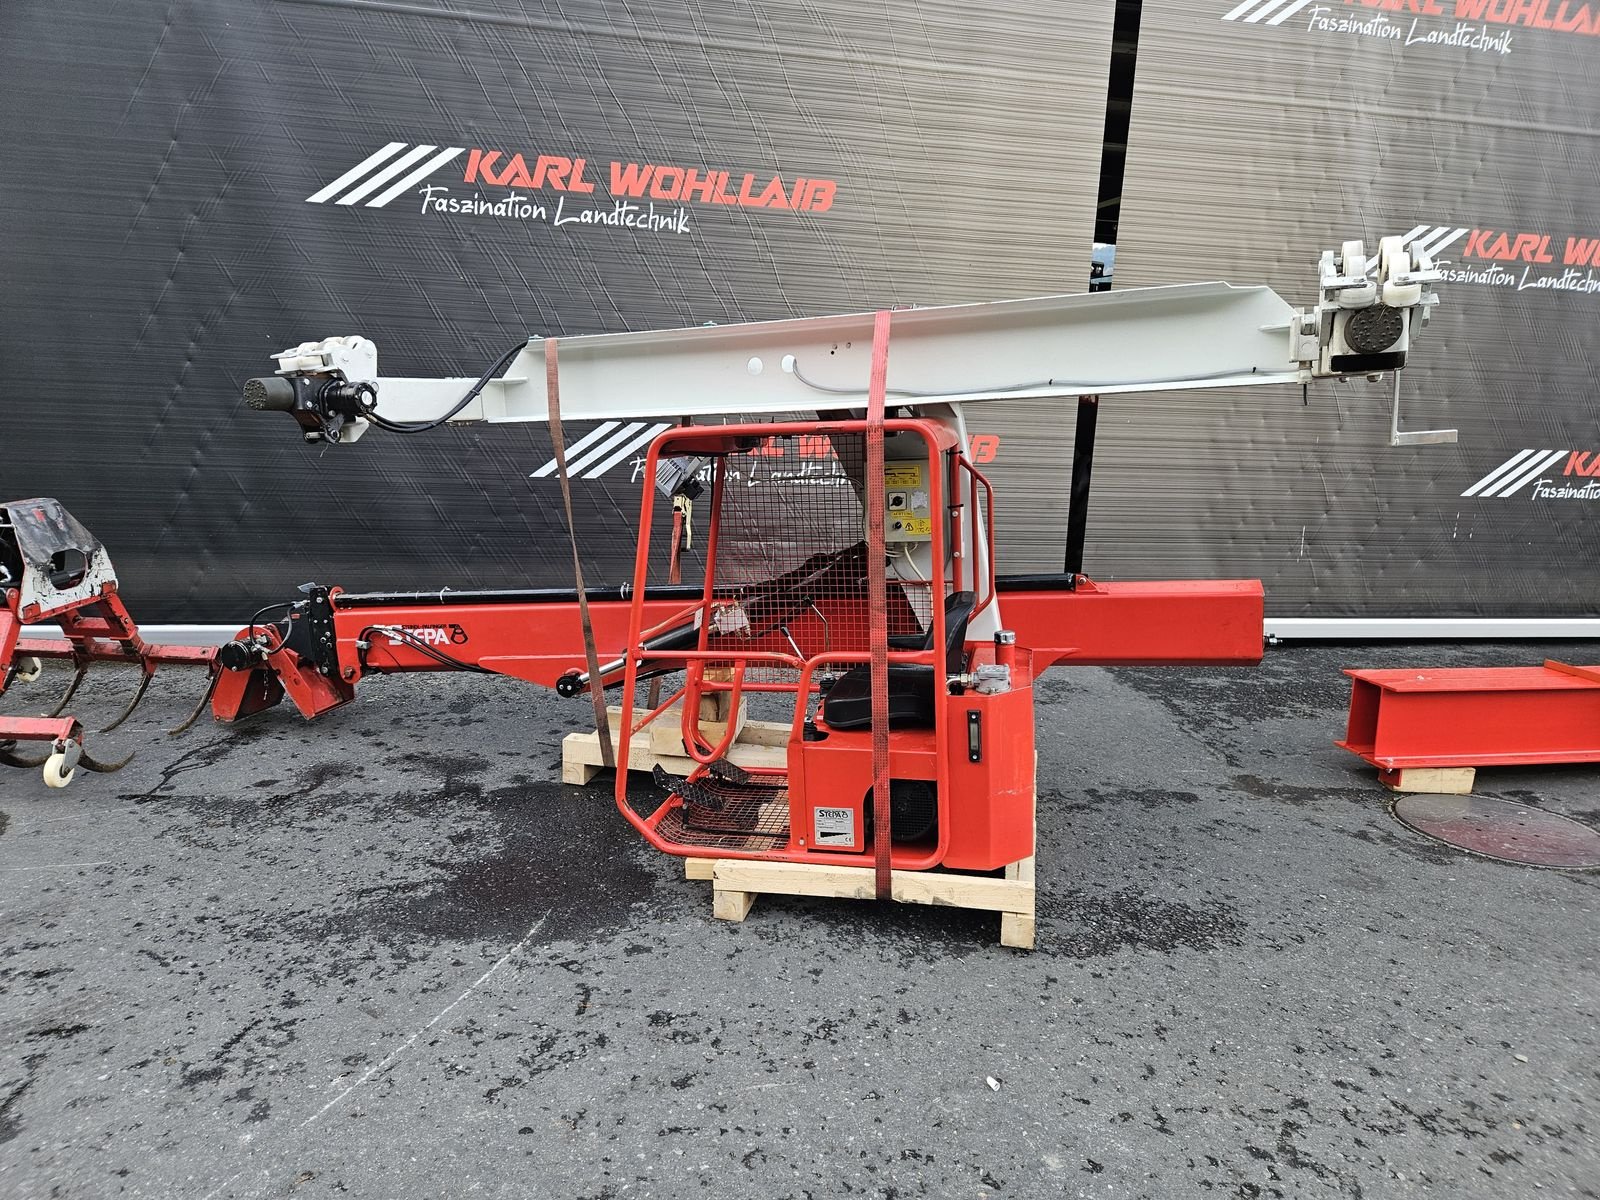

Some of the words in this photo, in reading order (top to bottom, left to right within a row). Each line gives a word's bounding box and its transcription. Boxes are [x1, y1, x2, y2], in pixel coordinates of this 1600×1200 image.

[1307, 5, 1401, 39] Faszination
[1405, 18, 1512, 54] Landtechnik
[464, 149, 595, 193] KARL
[419, 184, 547, 220] Faszination
[553, 195, 690, 233] Landtechnik
[1463, 229, 1553, 263] KARL
